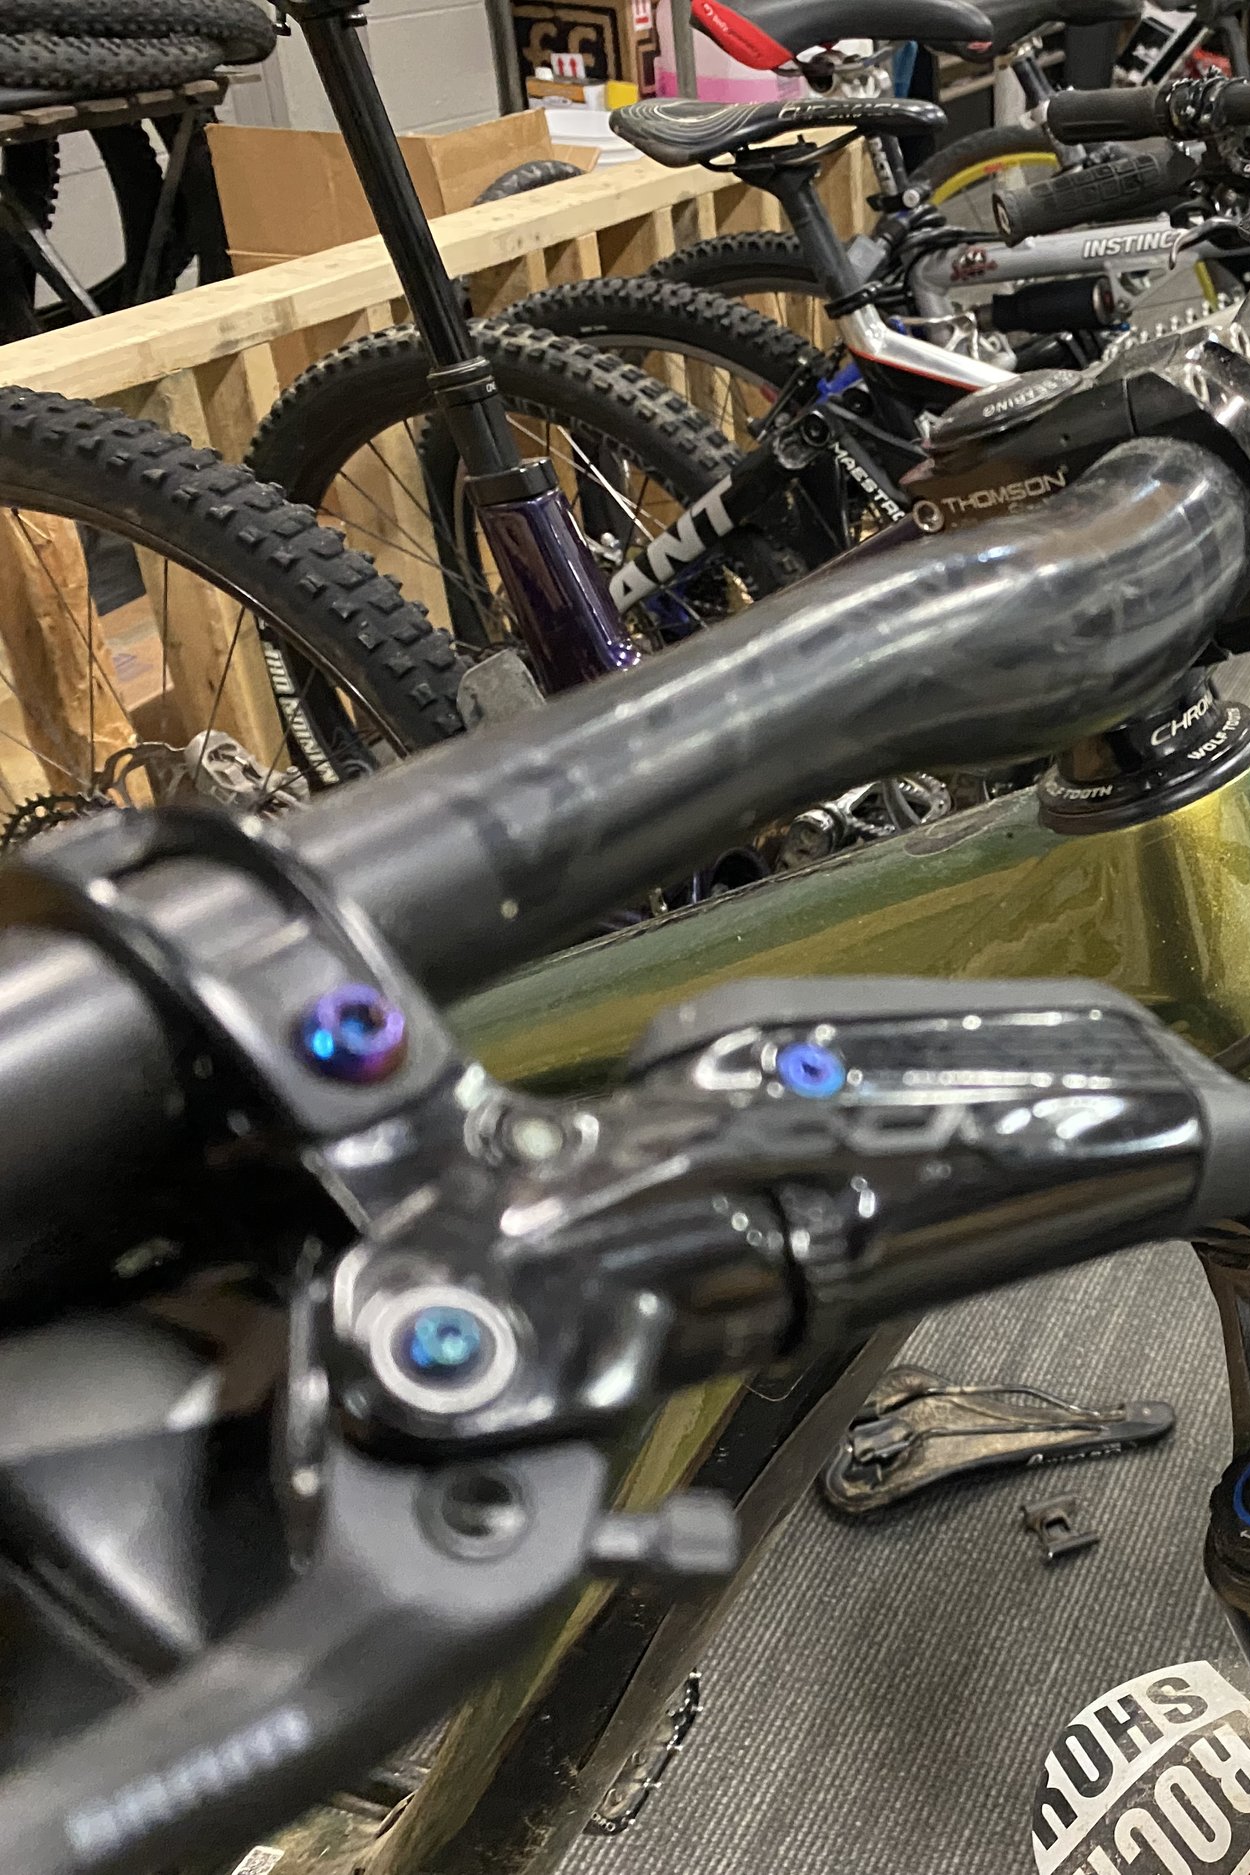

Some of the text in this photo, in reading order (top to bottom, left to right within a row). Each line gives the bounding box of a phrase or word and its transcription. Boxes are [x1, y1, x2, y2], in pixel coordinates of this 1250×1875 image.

[1083, 230, 1176, 259] INSTINC
[942, 470, 1067, 514] THOMSON
[1187, 731, 1228, 760] WOLF
[1062, 784, 1113, 799] TOOTH
